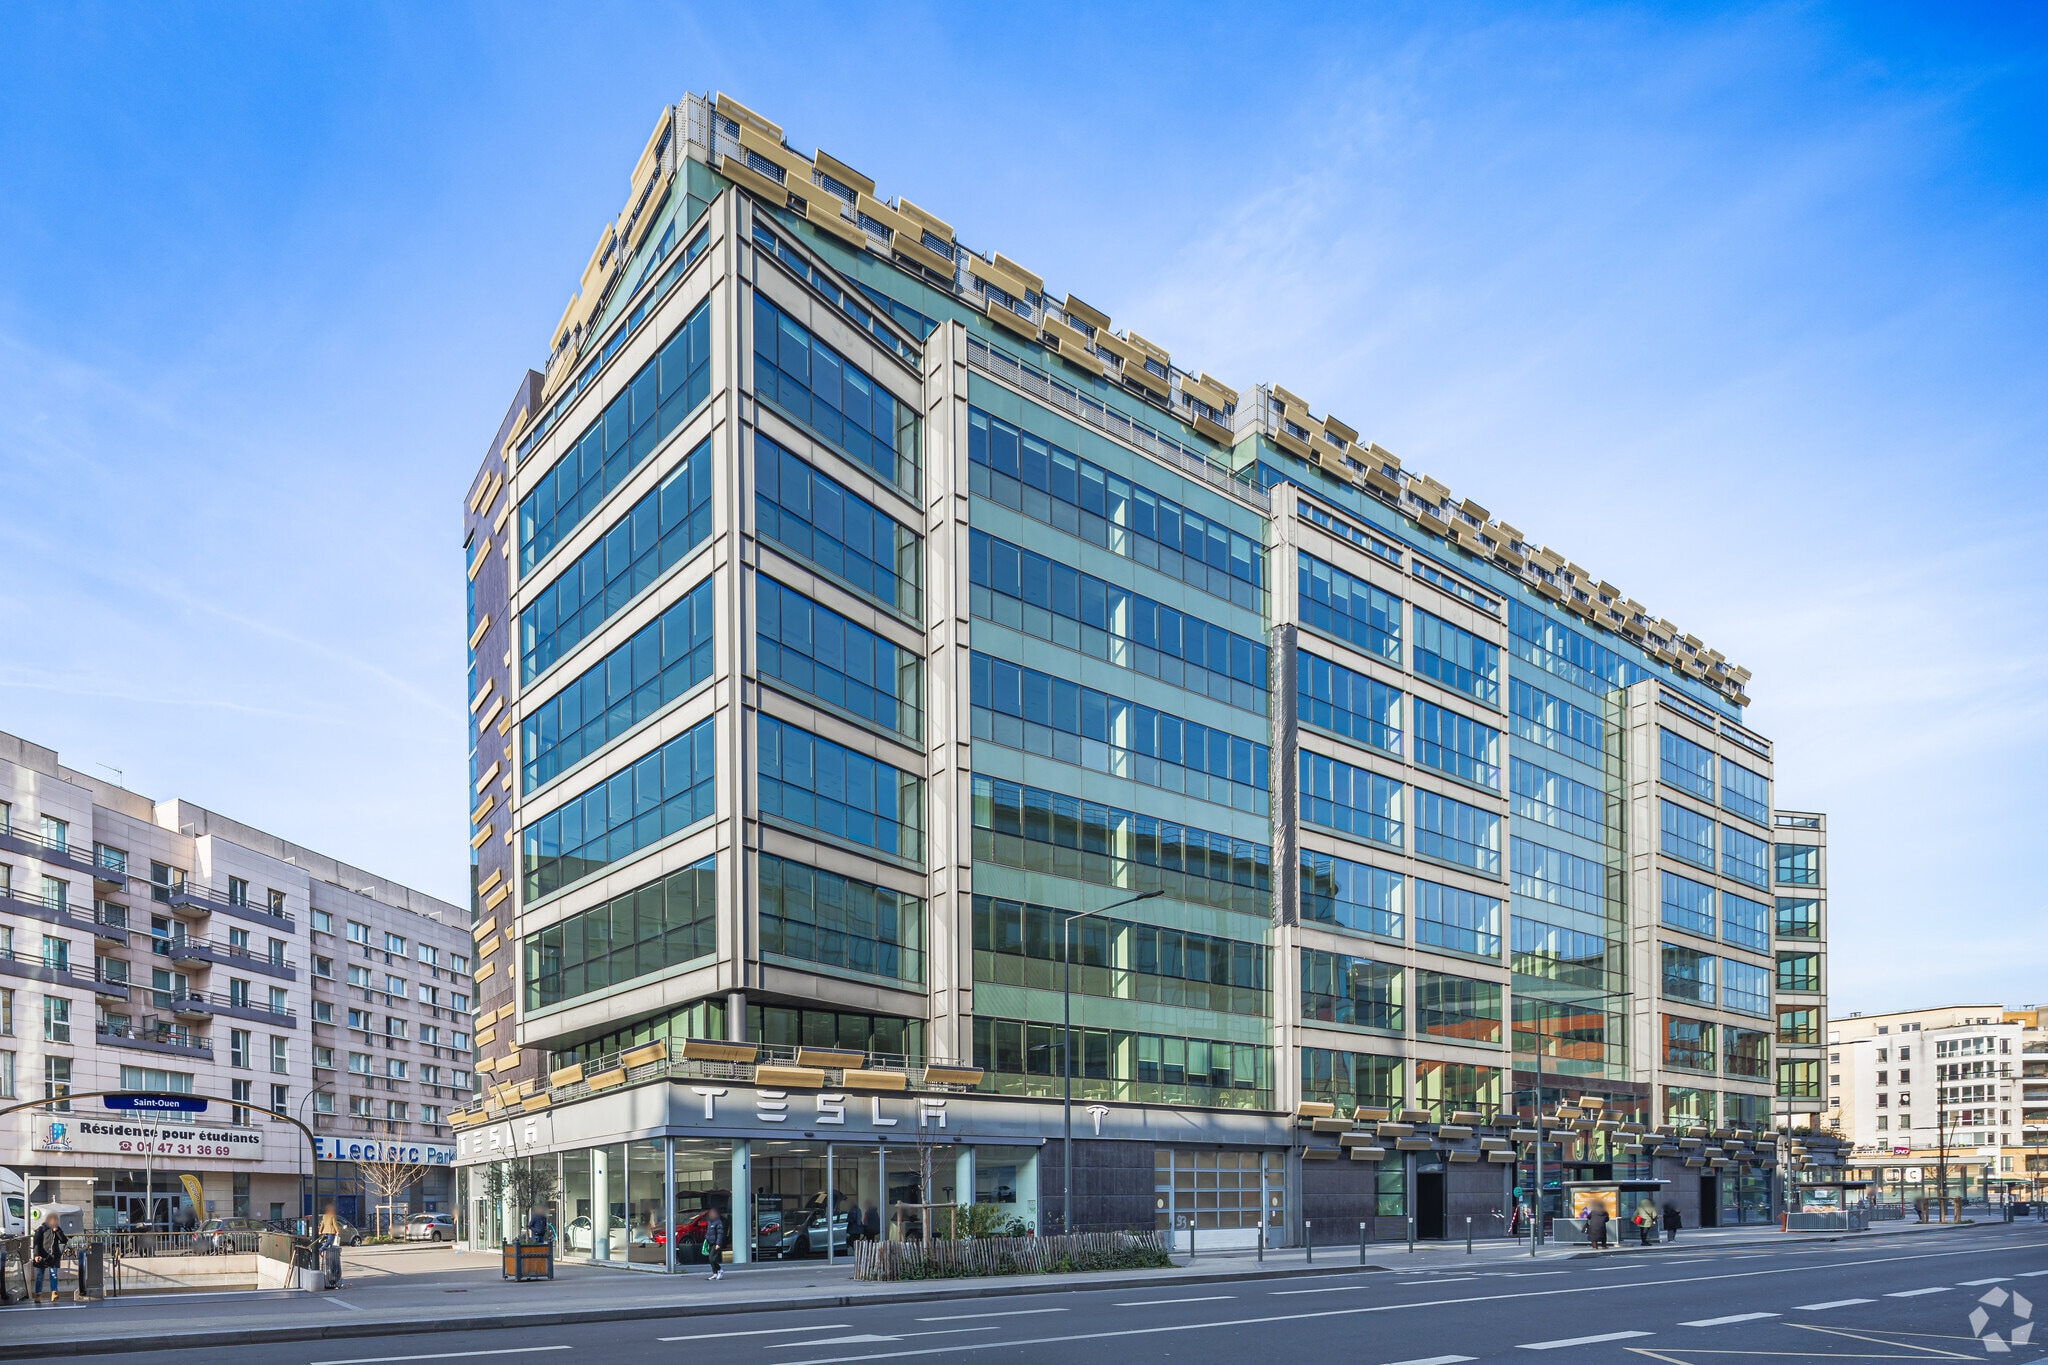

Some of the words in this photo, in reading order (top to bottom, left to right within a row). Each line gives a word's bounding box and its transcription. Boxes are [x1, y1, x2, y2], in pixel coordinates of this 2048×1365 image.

[133, 1098, 180, 1108] Saint-Ouen
[691, 1087, 948, 1128] TESLA
[80, 1122, 158, 1138] Résidence
[162, 1130, 196, 1141] pour
[199, 1130, 260, 1144] étudiants
[458, 1117, 538, 1156] TESLA
[136, 1141, 152, 1152] 01
[158, 1143, 173, 1154] 47
[177, 1144, 192, 1155] 31
[197, 1145, 212, 1155] 36
[215, 1146, 230, 1156] 69
[313, 1137, 419, 1162] E.Leclerc
[1910, 1170, 1917, 1179] C
